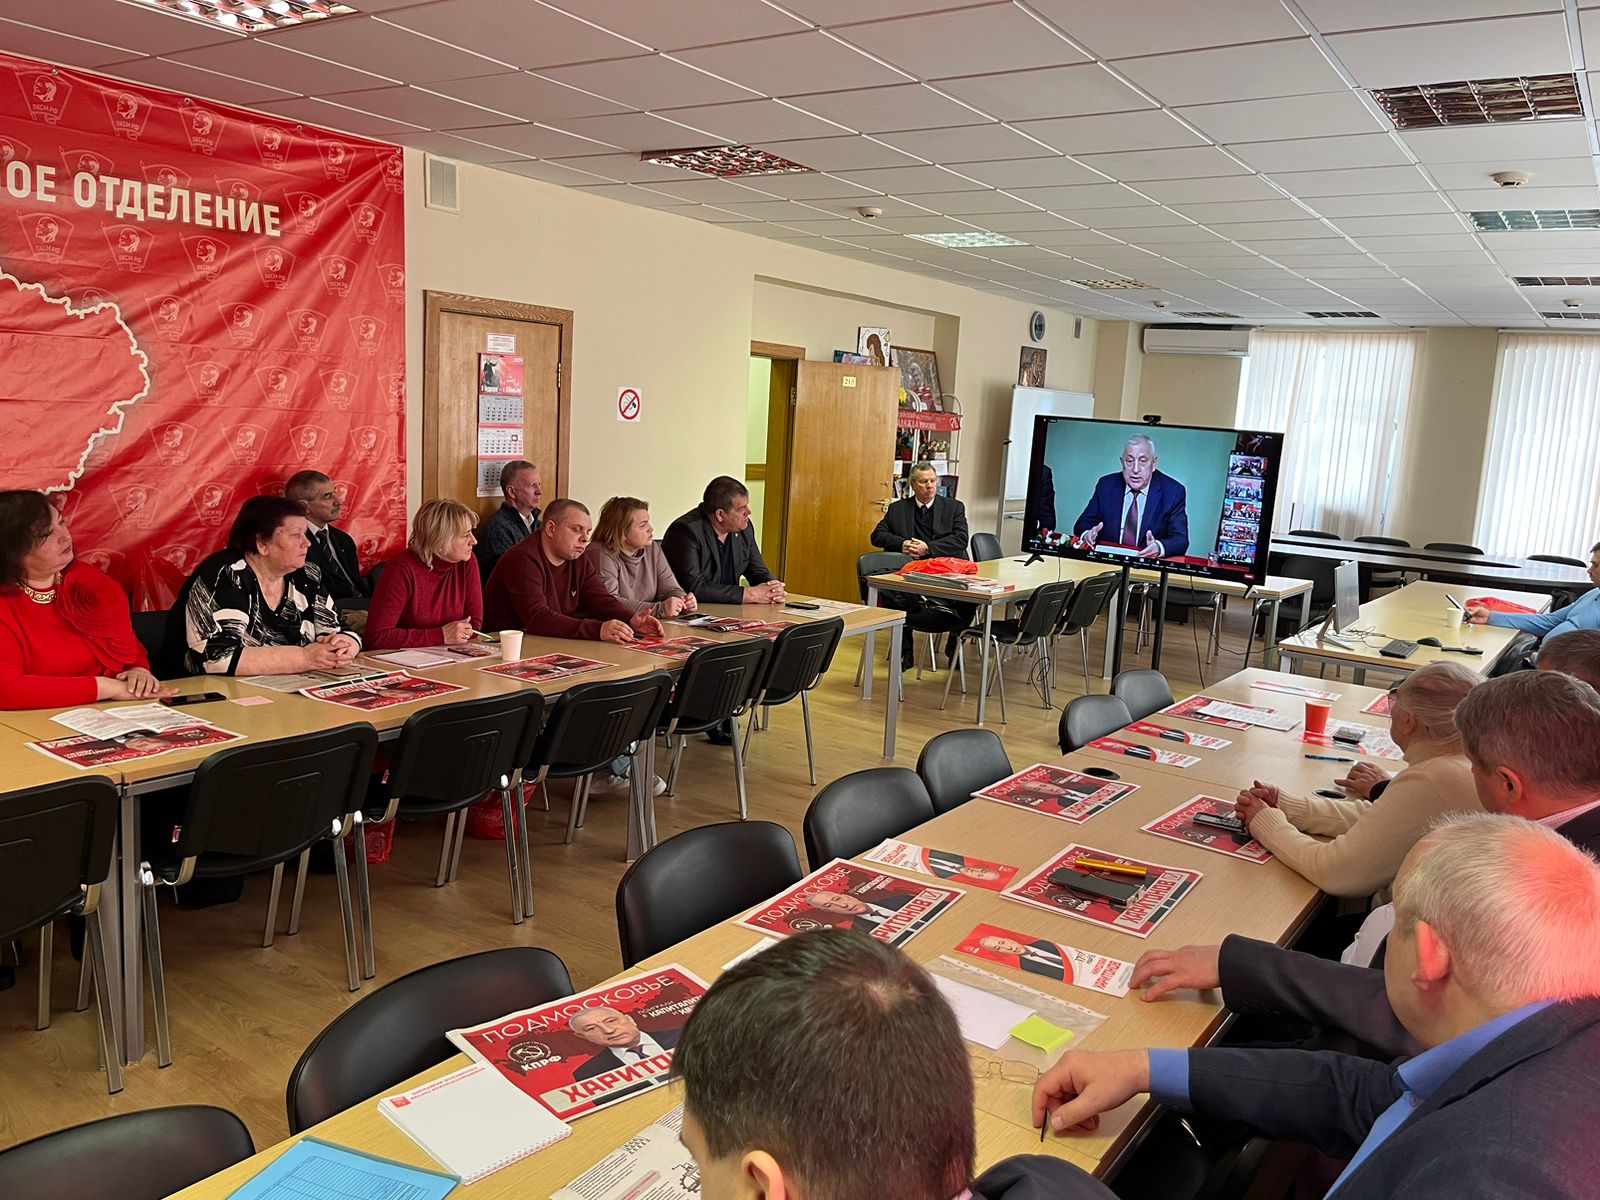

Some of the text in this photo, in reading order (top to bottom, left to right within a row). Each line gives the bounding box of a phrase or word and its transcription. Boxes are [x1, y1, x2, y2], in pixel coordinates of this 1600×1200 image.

[6, 160, 281, 237] ОЕ ОТДЕЛЕНИЕ
[844, 378, 855, 386] 215
[758, 866, 852, 925] ПОДМОСКОВЬЕ
[870, 898, 933, 942] РИТОНОВ
[482, 975, 676, 1043] ПОДМОСКОВЬЕ
[521, 1054, 562, 1072] КПРФ
